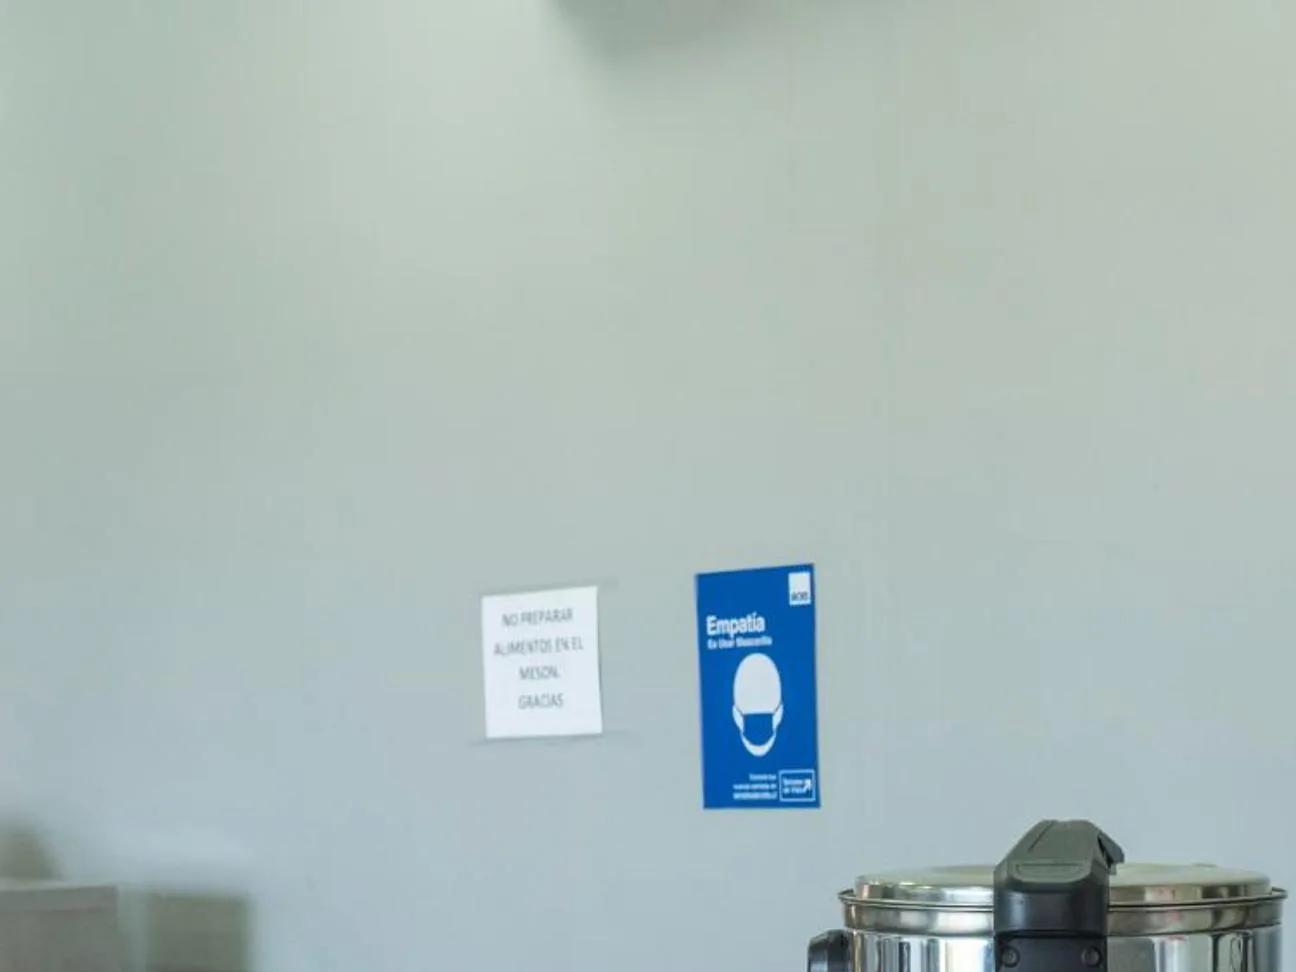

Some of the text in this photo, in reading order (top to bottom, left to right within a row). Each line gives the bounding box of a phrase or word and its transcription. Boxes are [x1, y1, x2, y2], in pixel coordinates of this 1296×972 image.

[501, 608, 574, 626] NO PREPARAR
[706, 611, 766, 639] Empatía
[494, 636, 584, 656] ALIMENTOS EN EL
[518, 692, 564, 709] GRACIAS
